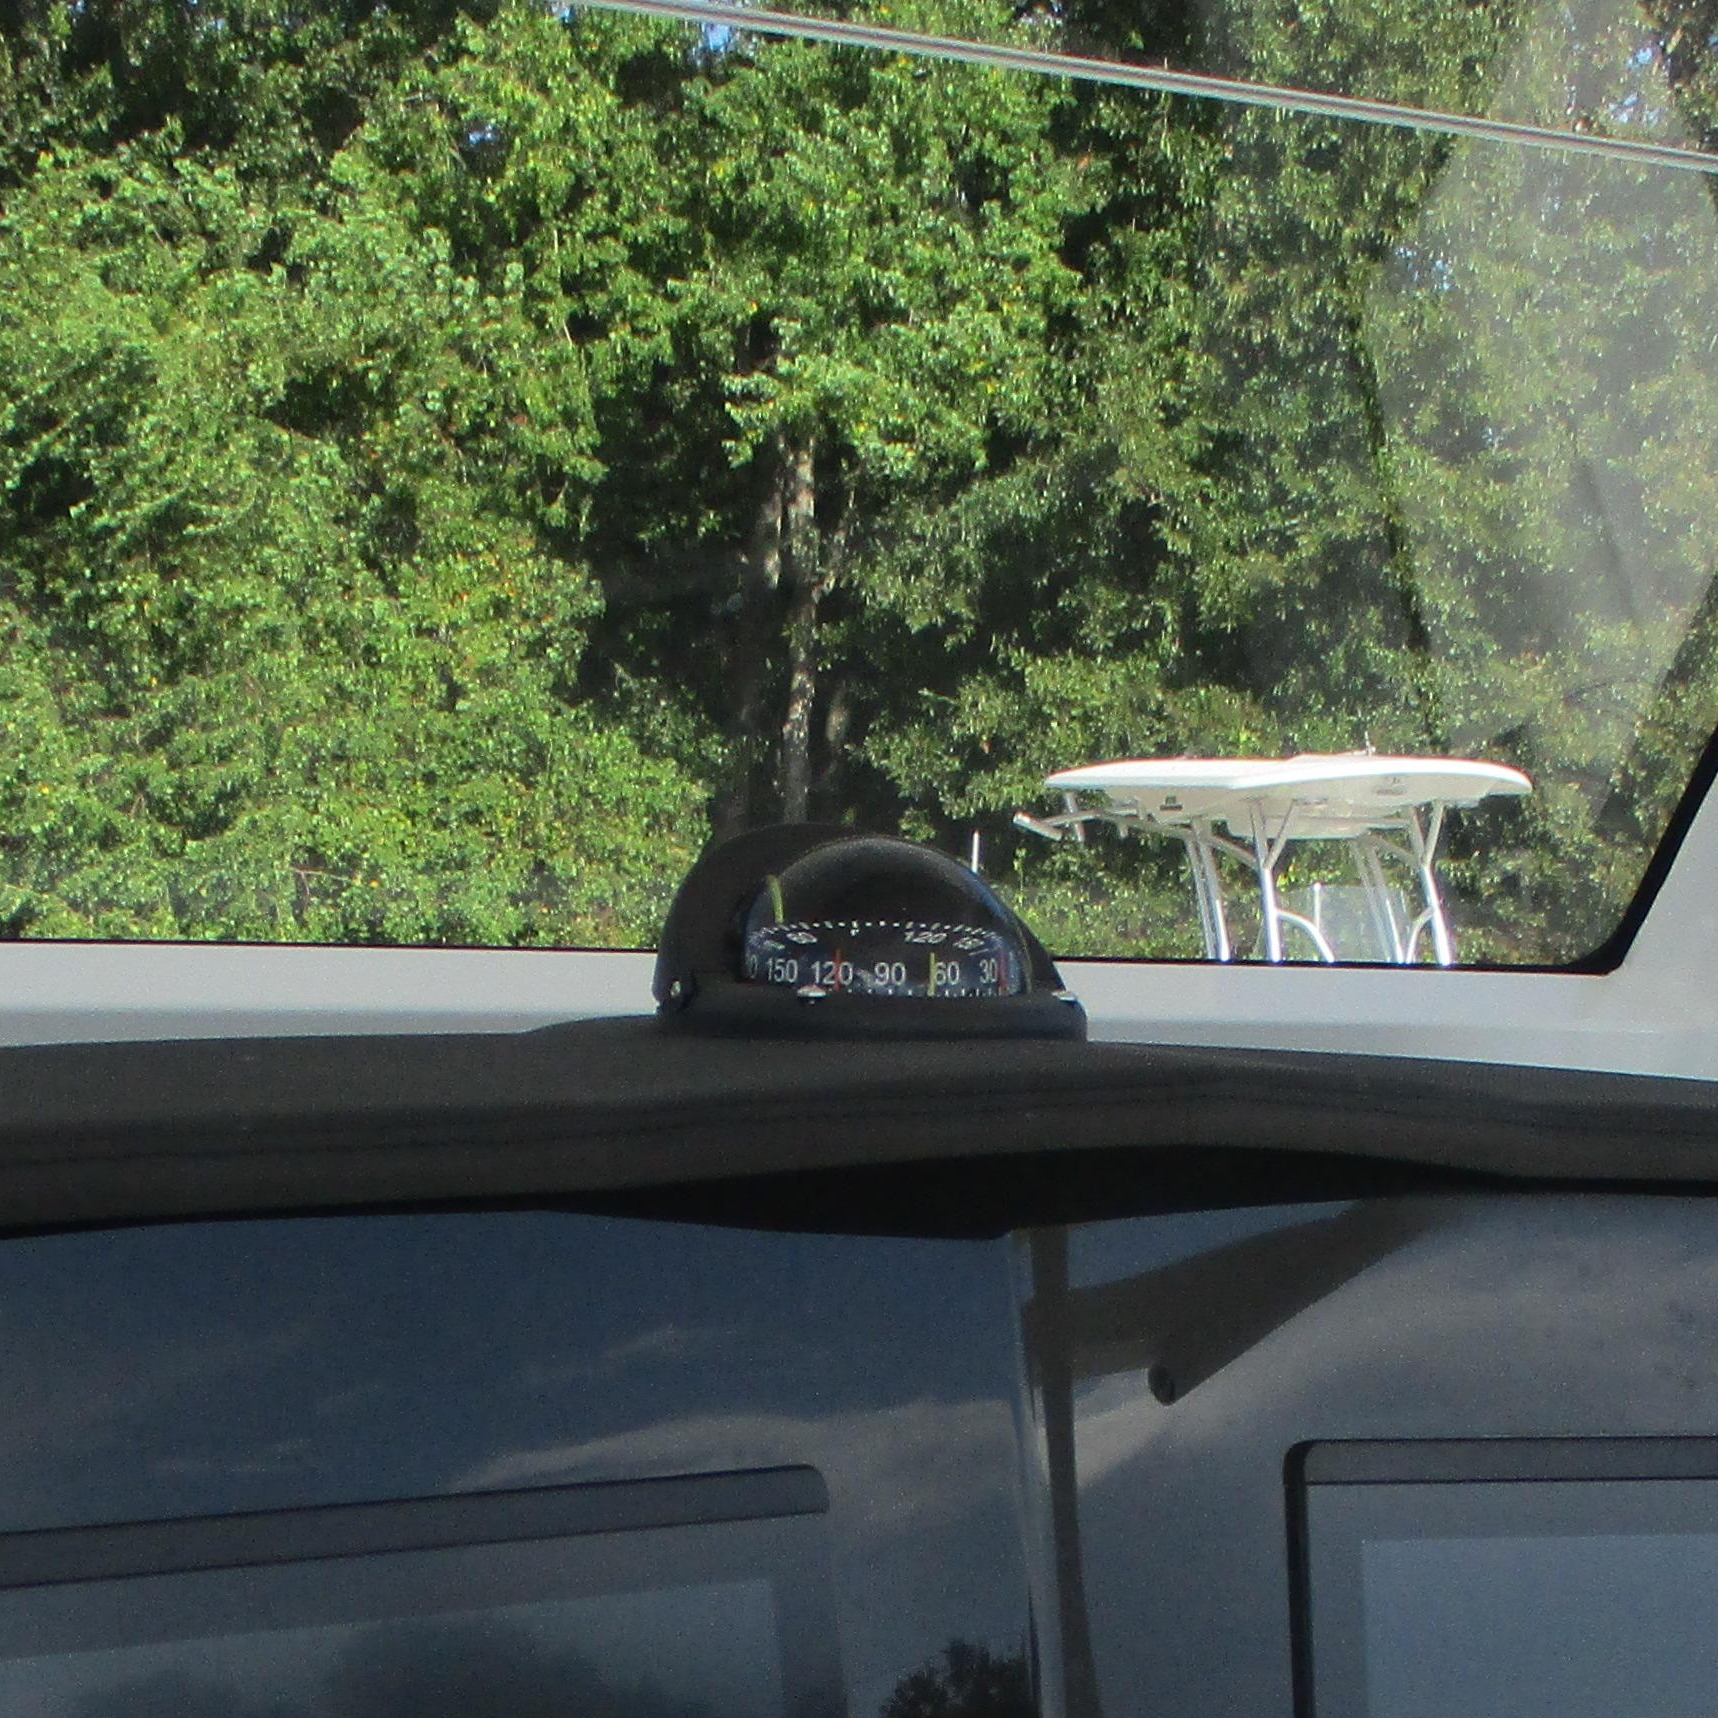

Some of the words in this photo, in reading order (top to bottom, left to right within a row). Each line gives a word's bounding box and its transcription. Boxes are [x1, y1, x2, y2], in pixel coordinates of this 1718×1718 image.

[766, 958, 798, 983] 150
[811, 961, 853, 985] 120
[874, 962, 906, 985] 90
[934, 961, 960, 985] 60
[979, 958, 998, 983] 30
